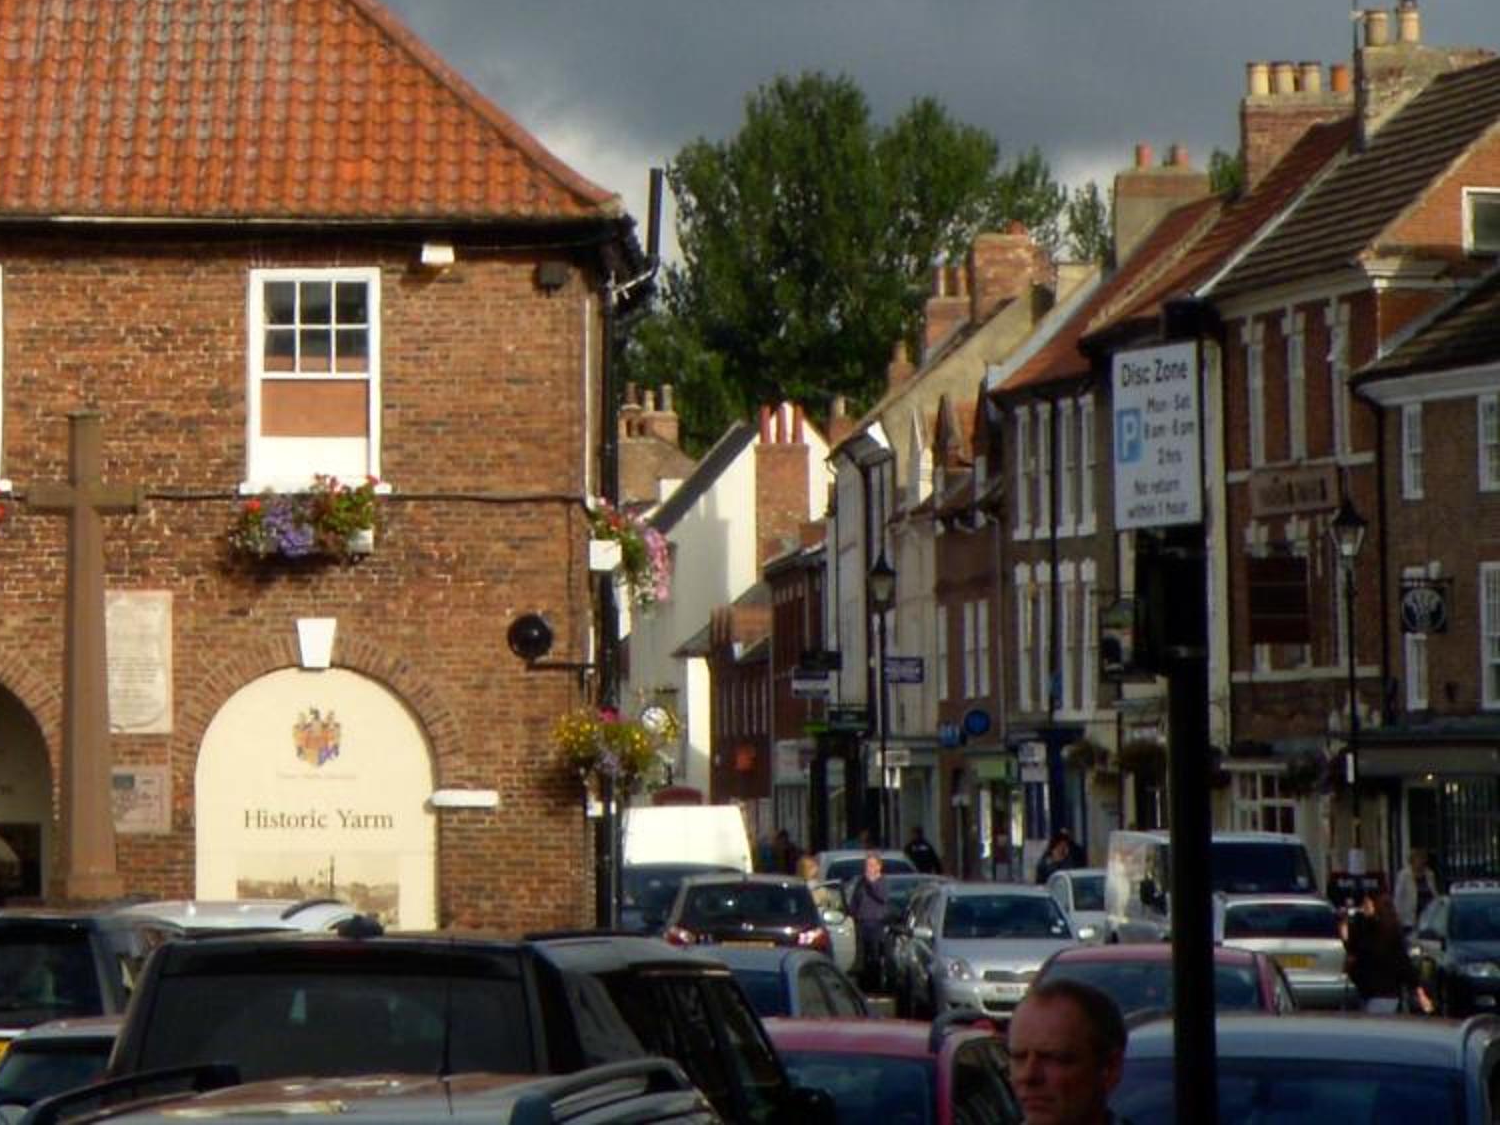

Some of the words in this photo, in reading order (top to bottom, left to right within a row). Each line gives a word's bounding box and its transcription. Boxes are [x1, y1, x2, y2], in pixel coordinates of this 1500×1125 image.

[1121, 362, 1150, 388] Disc
[1155, 358, 1188, 383] Zone
[1122, 414, 1139, 460] P
[244, 808, 328, 829] Historic
[336, 808, 395, 829] Yarm
